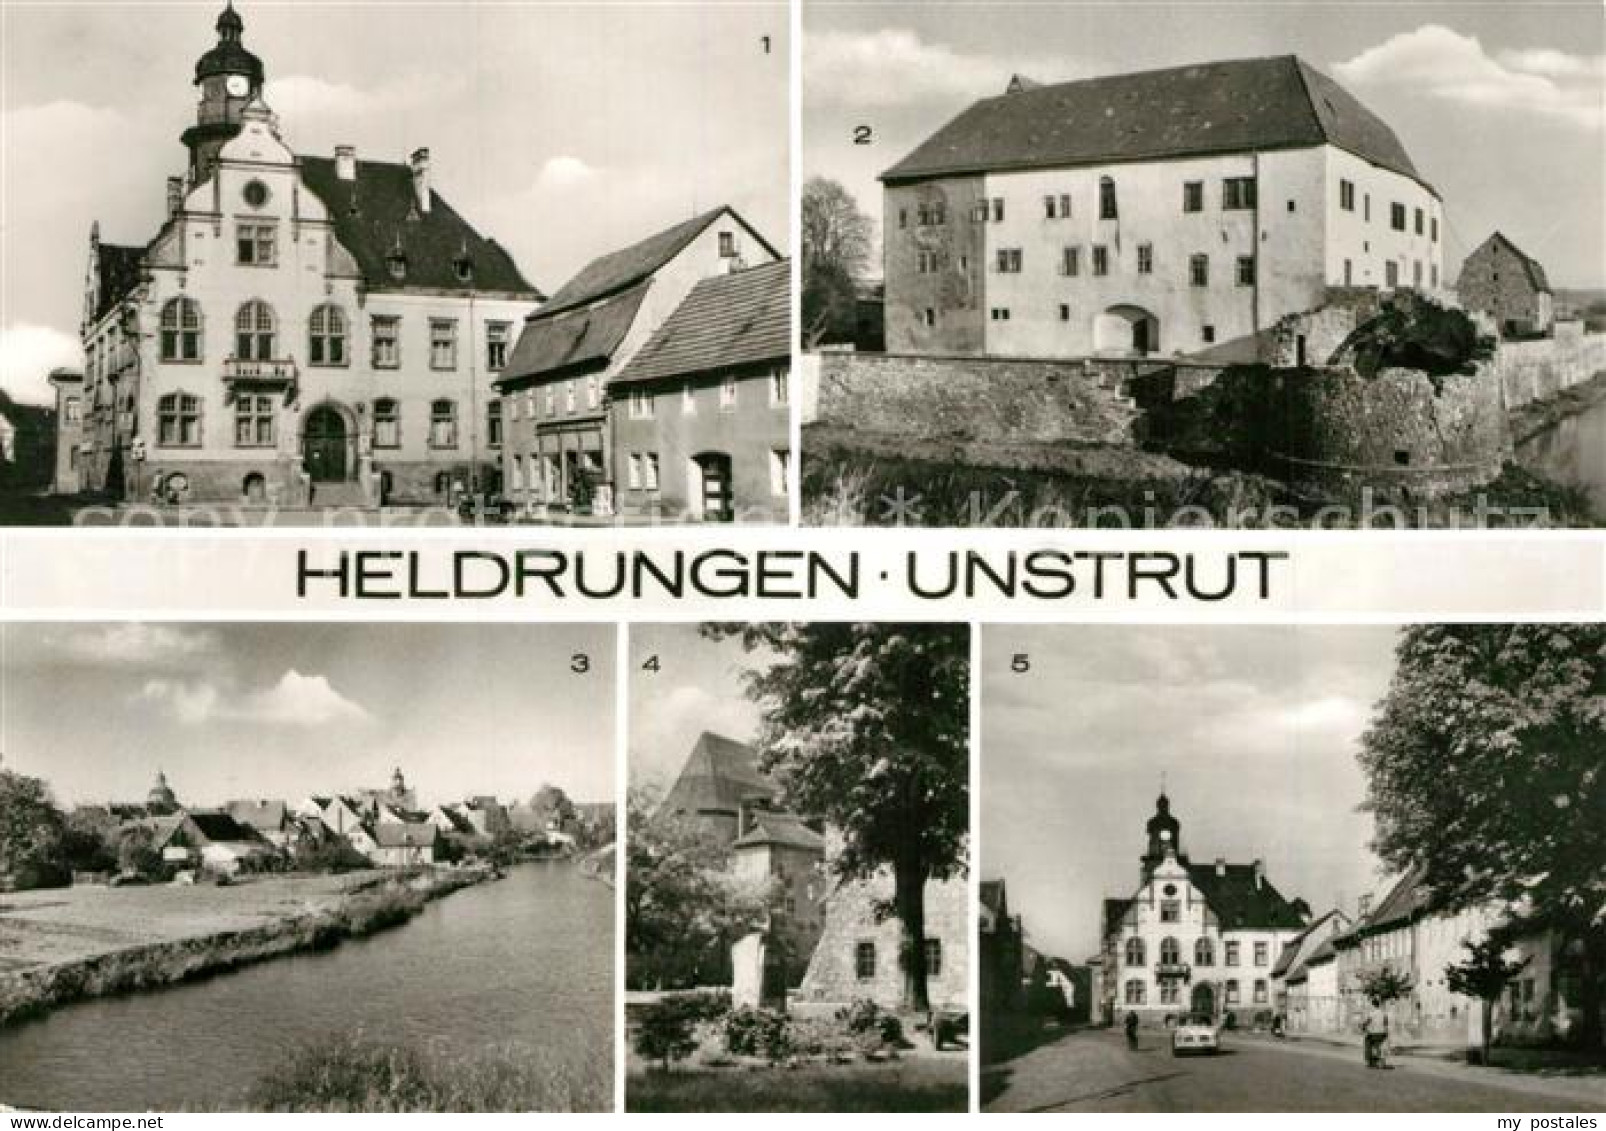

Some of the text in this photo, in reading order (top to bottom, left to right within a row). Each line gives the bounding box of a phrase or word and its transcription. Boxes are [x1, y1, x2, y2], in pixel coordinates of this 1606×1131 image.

[761, 35, 771, 54] 1
[853, 125, 873, 146] 2
[297, 548, 1290, 601] HELDRUNGEN UNSTRUT
[570, 653, 591, 674] 3
[641, 654, 661, 673] 4
[1011, 653, 1031, 673] 5
